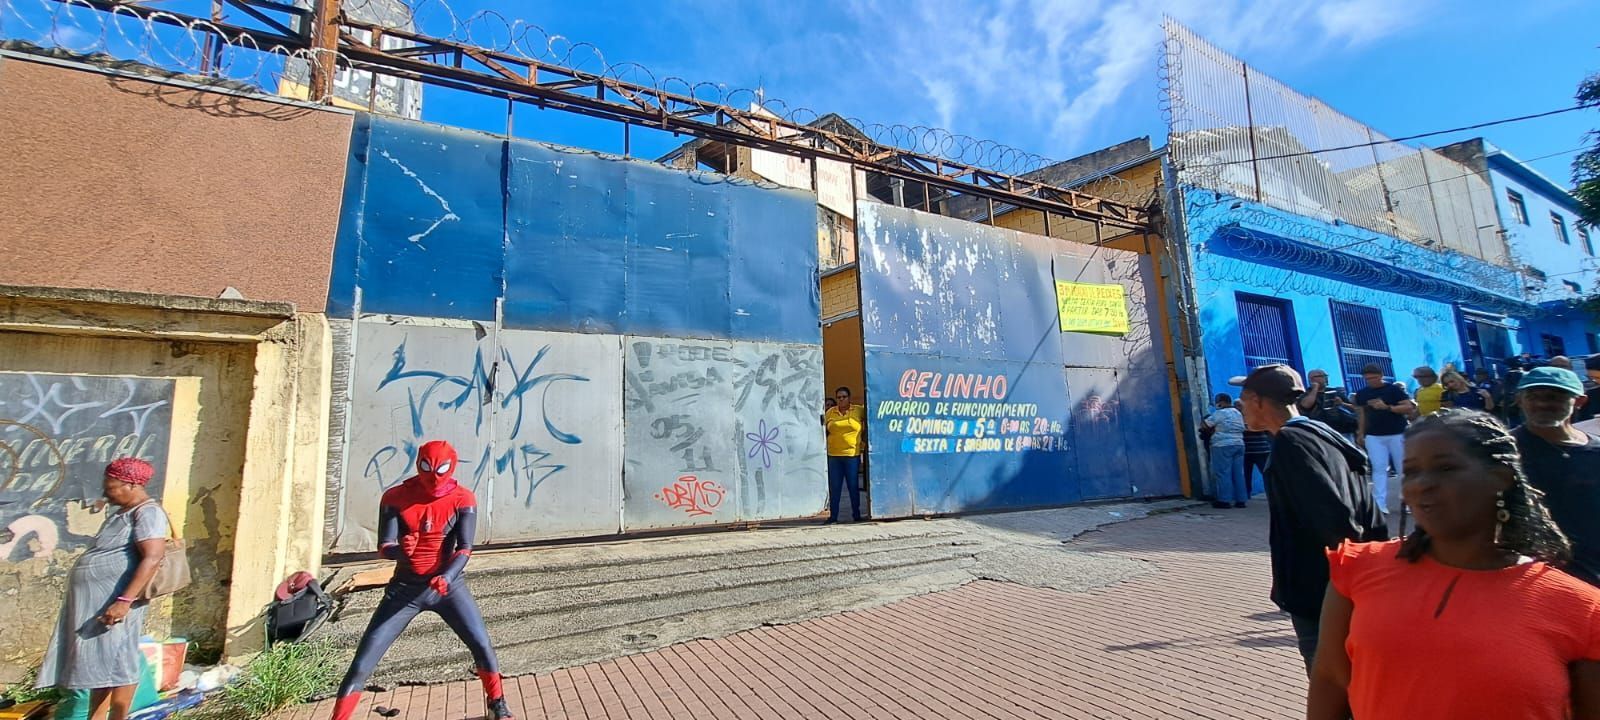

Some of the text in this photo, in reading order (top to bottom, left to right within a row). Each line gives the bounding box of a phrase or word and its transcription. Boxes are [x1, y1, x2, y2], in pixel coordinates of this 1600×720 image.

[899, 369, 1007, 399] GELINHO
[935, 402, 948, 415] DE
[951, 402, 1038, 418] FUNCIONAMENTO
[889, 419, 903, 432] DE
[906, 417, 954, 435] DOMINGO
[914, 437, 947, 452] SEXTA
[955, 438, 962, 452] E
[1004, 438, 1014, 451] DE
